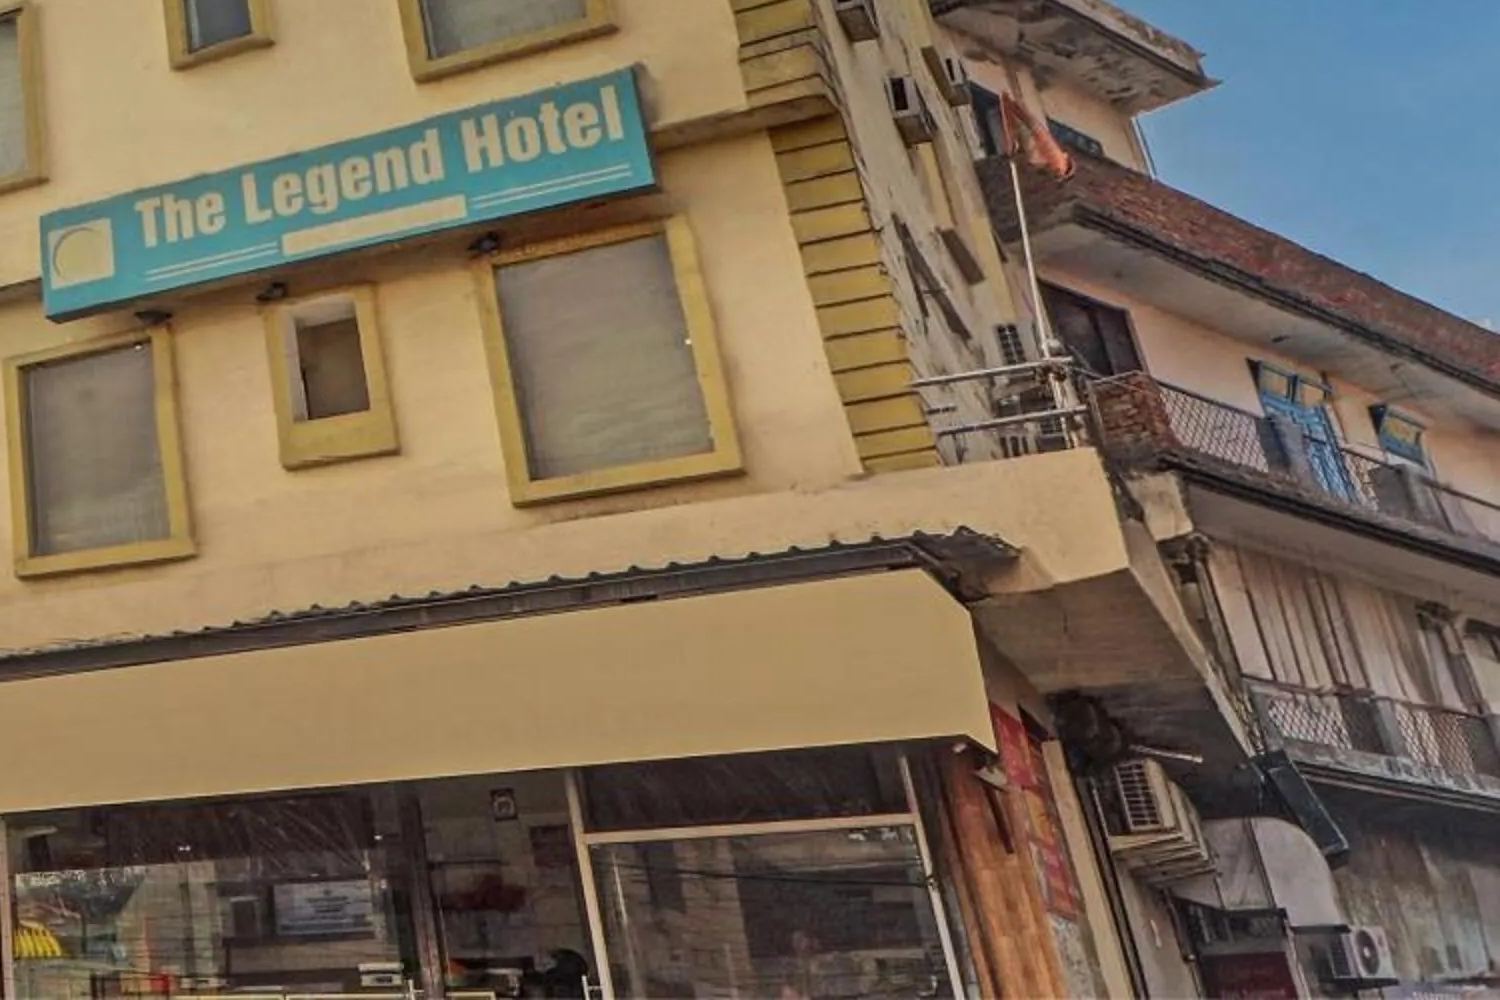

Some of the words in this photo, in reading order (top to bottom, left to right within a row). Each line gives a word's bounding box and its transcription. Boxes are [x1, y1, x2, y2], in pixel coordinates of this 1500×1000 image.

[135, 189, 226, 248] The
[241, 129, 444, 225] Legend
[461, 85, 625, 173] Hotel
